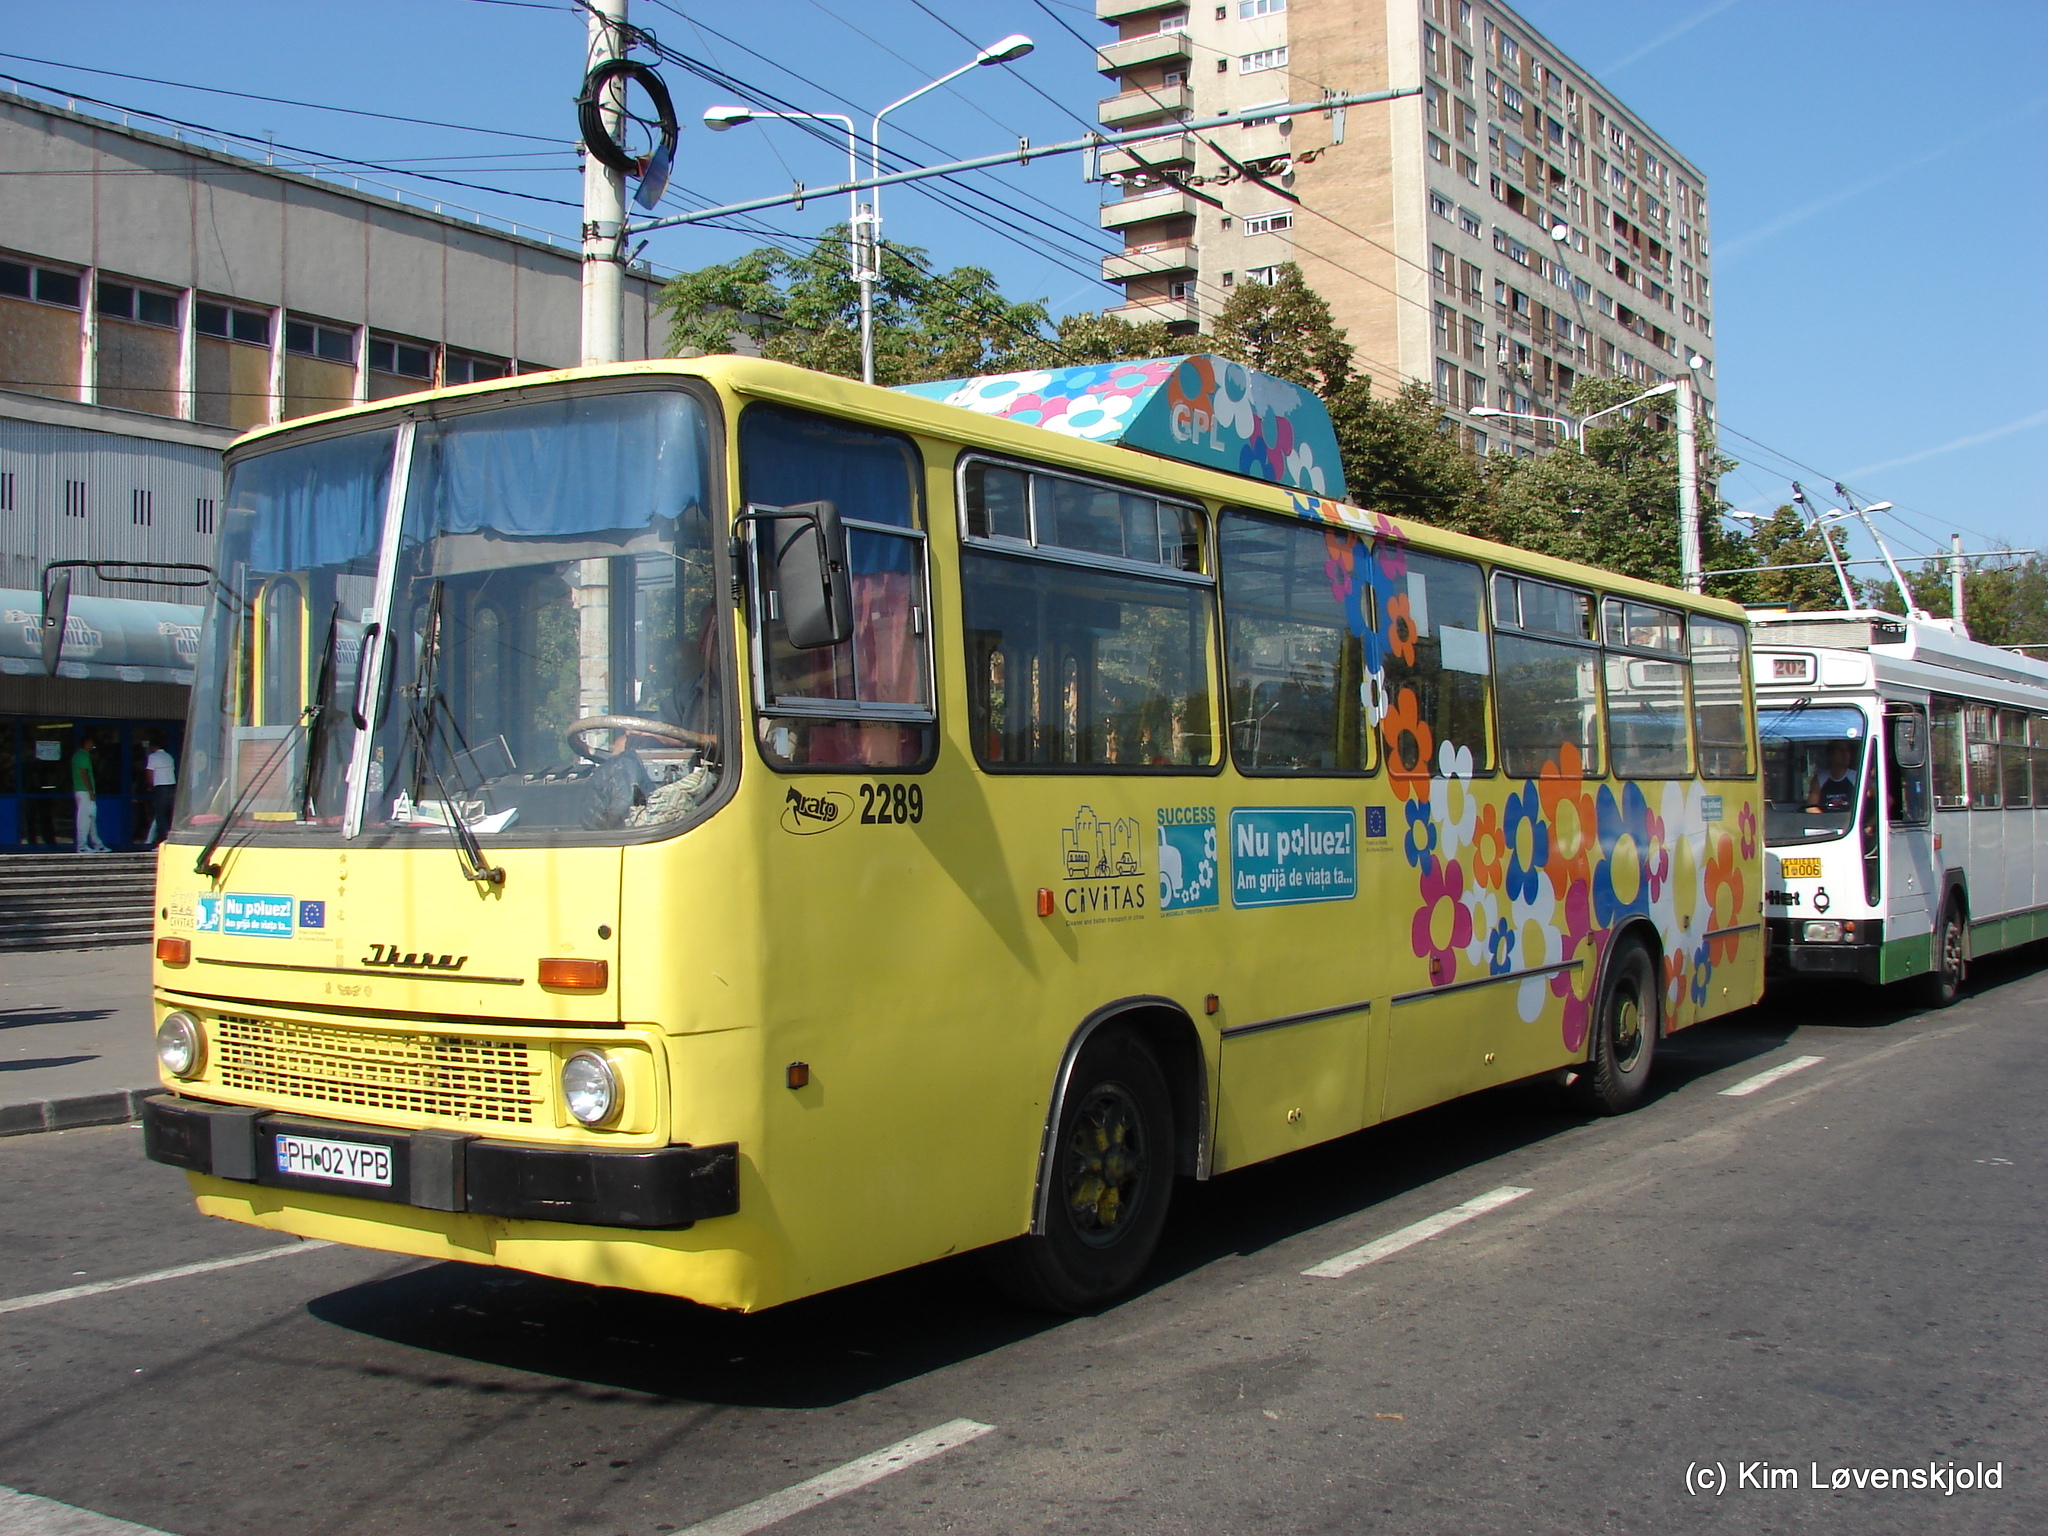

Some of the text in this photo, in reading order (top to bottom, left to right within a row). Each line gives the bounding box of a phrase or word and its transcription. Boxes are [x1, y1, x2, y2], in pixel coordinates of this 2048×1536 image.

[1171, 402, 1225, 452] GPL
[1774, 660, 1806, 675] 202
[800, 796, 838, 821] ratp
[859, 783, 923, 824] 2289
[1157, 806, 1216, 825] SUCCESS
[1237, 823, 1350, 864] Nu poluez!
[1237, 870, 1256, 889] Am
[1260, 868, 1286, 893] grijă
[1289, 867, 1302, 886] de
[1785, 865, 1820, 876] 1 006
[226, 898, 291, 918] Nu poluez!
